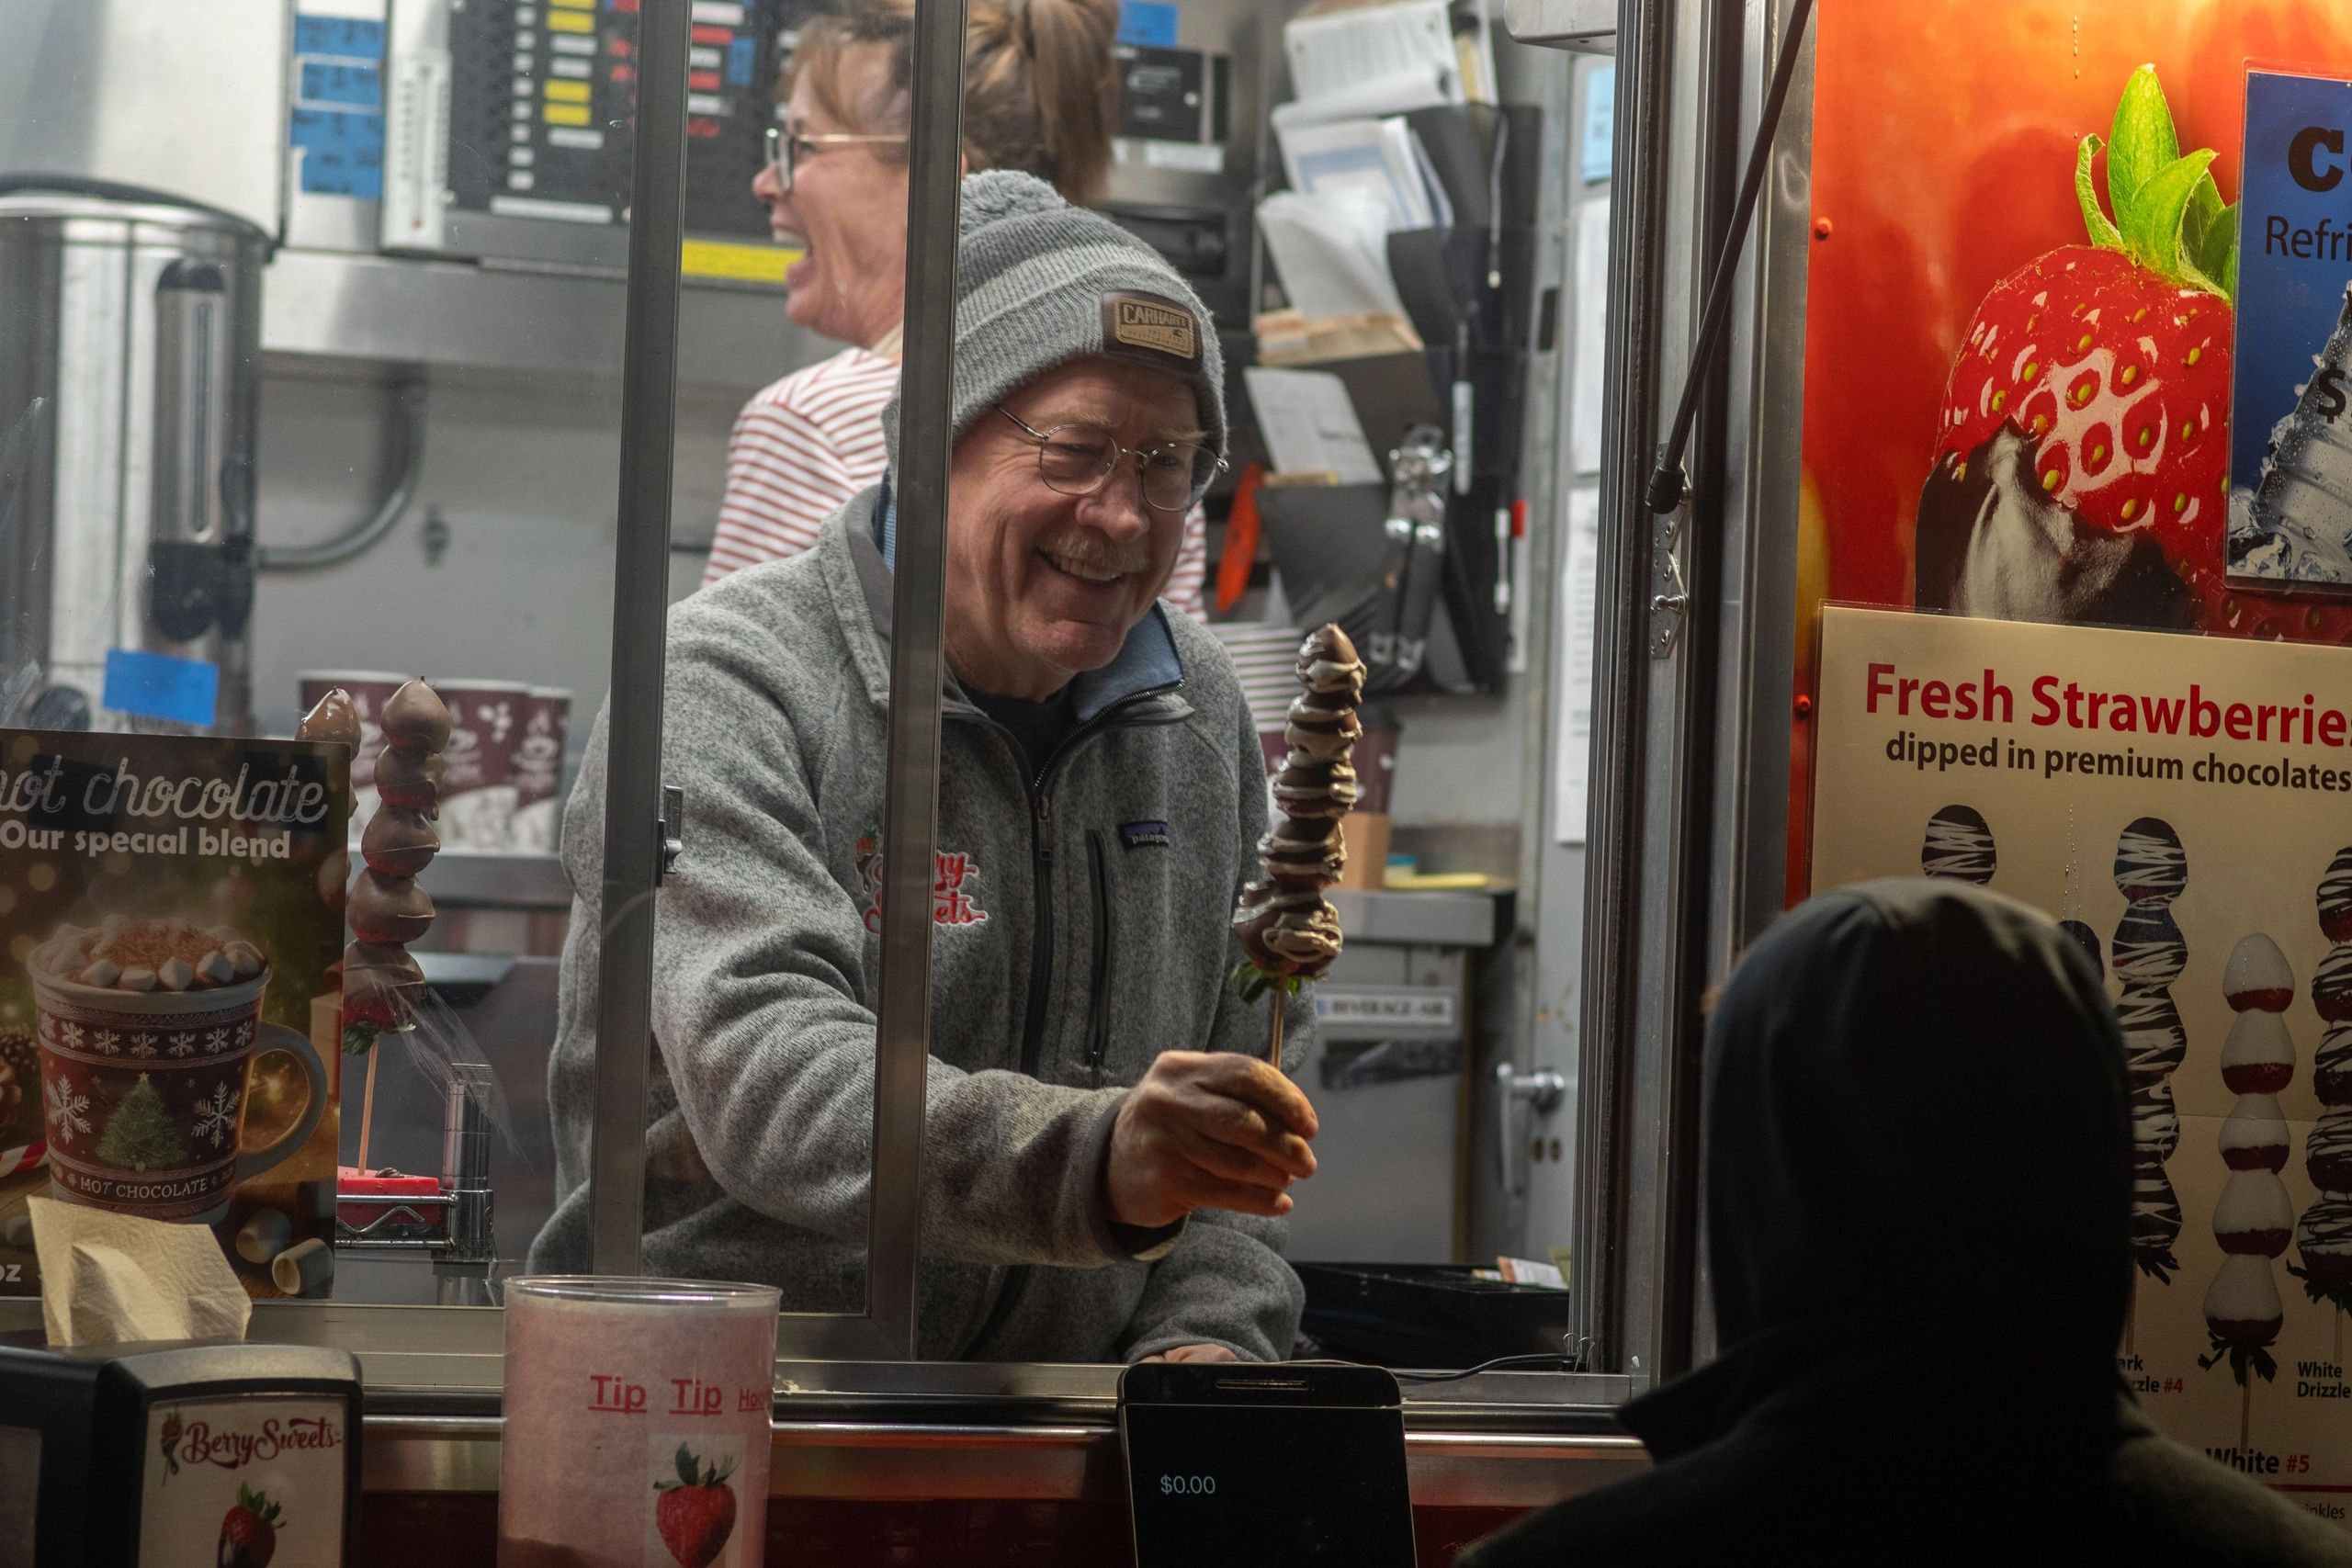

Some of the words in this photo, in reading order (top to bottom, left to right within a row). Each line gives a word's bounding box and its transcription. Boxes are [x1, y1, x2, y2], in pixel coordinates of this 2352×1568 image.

[2289, 127, 2352, 193] C
[1867, 662, 2014, 723] Fresh
[2030, 675, 2352, 748] Strawberrie
[1886, 730, 1998, 772] dipped
[2007, 739, 2035, 770] in
[2045, 747, 2184, 780] premium
[2192, 752, 2352, 792] chocolates
[83, 756, 329, 824] chocolate
[0, 819, 65, 850] Our
[74, 827, 187, 857] special
[198, 826, 291, 859] blend
[116, 1177, 208, 1199] CHOCOLATE
[2117, 1354, 2143, 1371] ark
[2298, 1361, 2342, 1379] White
[590, 1375, 647, 1414] Tip
[672, 1379, 722, 1416] Tip
[2164, 1377, 2184, 1393] #4
[2297, 1382, 2352, 1399] Drizzle
[2286, 1454, 2310, 1474] #5
[1160, 1474, 1216, 1495] $0.00
